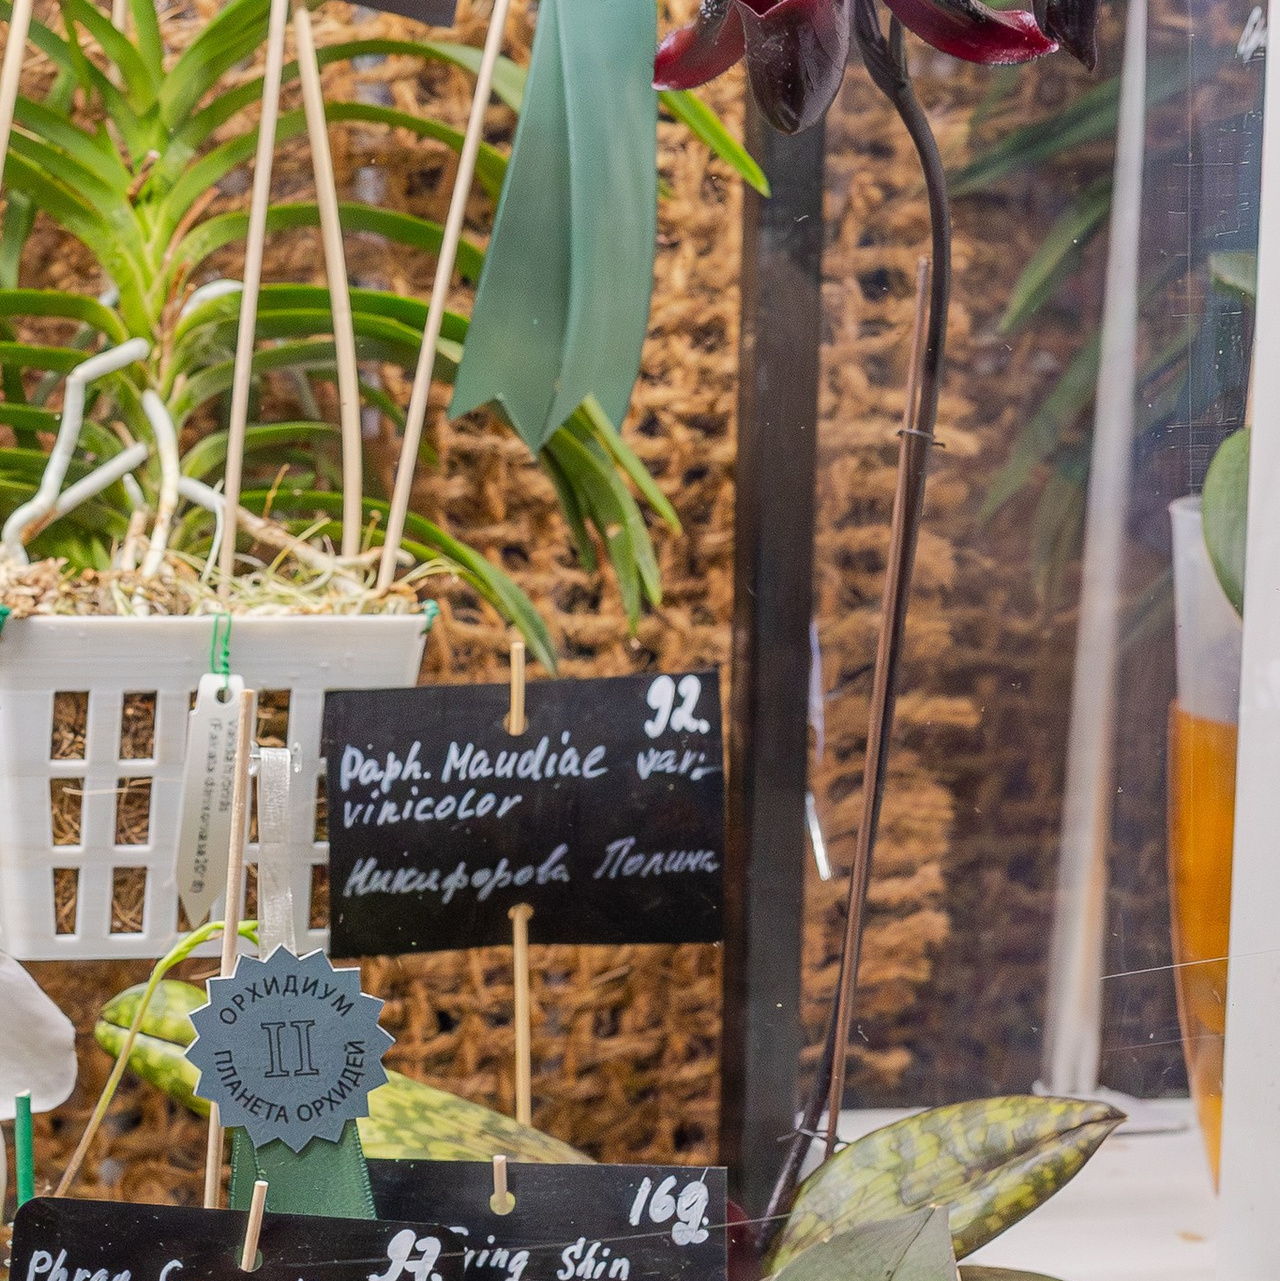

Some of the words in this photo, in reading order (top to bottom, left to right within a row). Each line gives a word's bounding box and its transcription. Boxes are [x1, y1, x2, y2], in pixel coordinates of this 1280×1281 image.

[441, 731, 609, 783] Maudiae
[343, 788, 522, 830] vinicolor
[343, 843, 571, 904] Никифорова
[593, 836, 719, 879] Полина
[220, 975, 354, 1025] ОРХИДИУМ
[261, 1020, 320, 1078] II
[214, 1050, 289, 1124] ПЛАНЕТА
[297, 1040, 366, 1122] ОРХИДЕЙ
[556, 1236, 630, 1281] Shin
